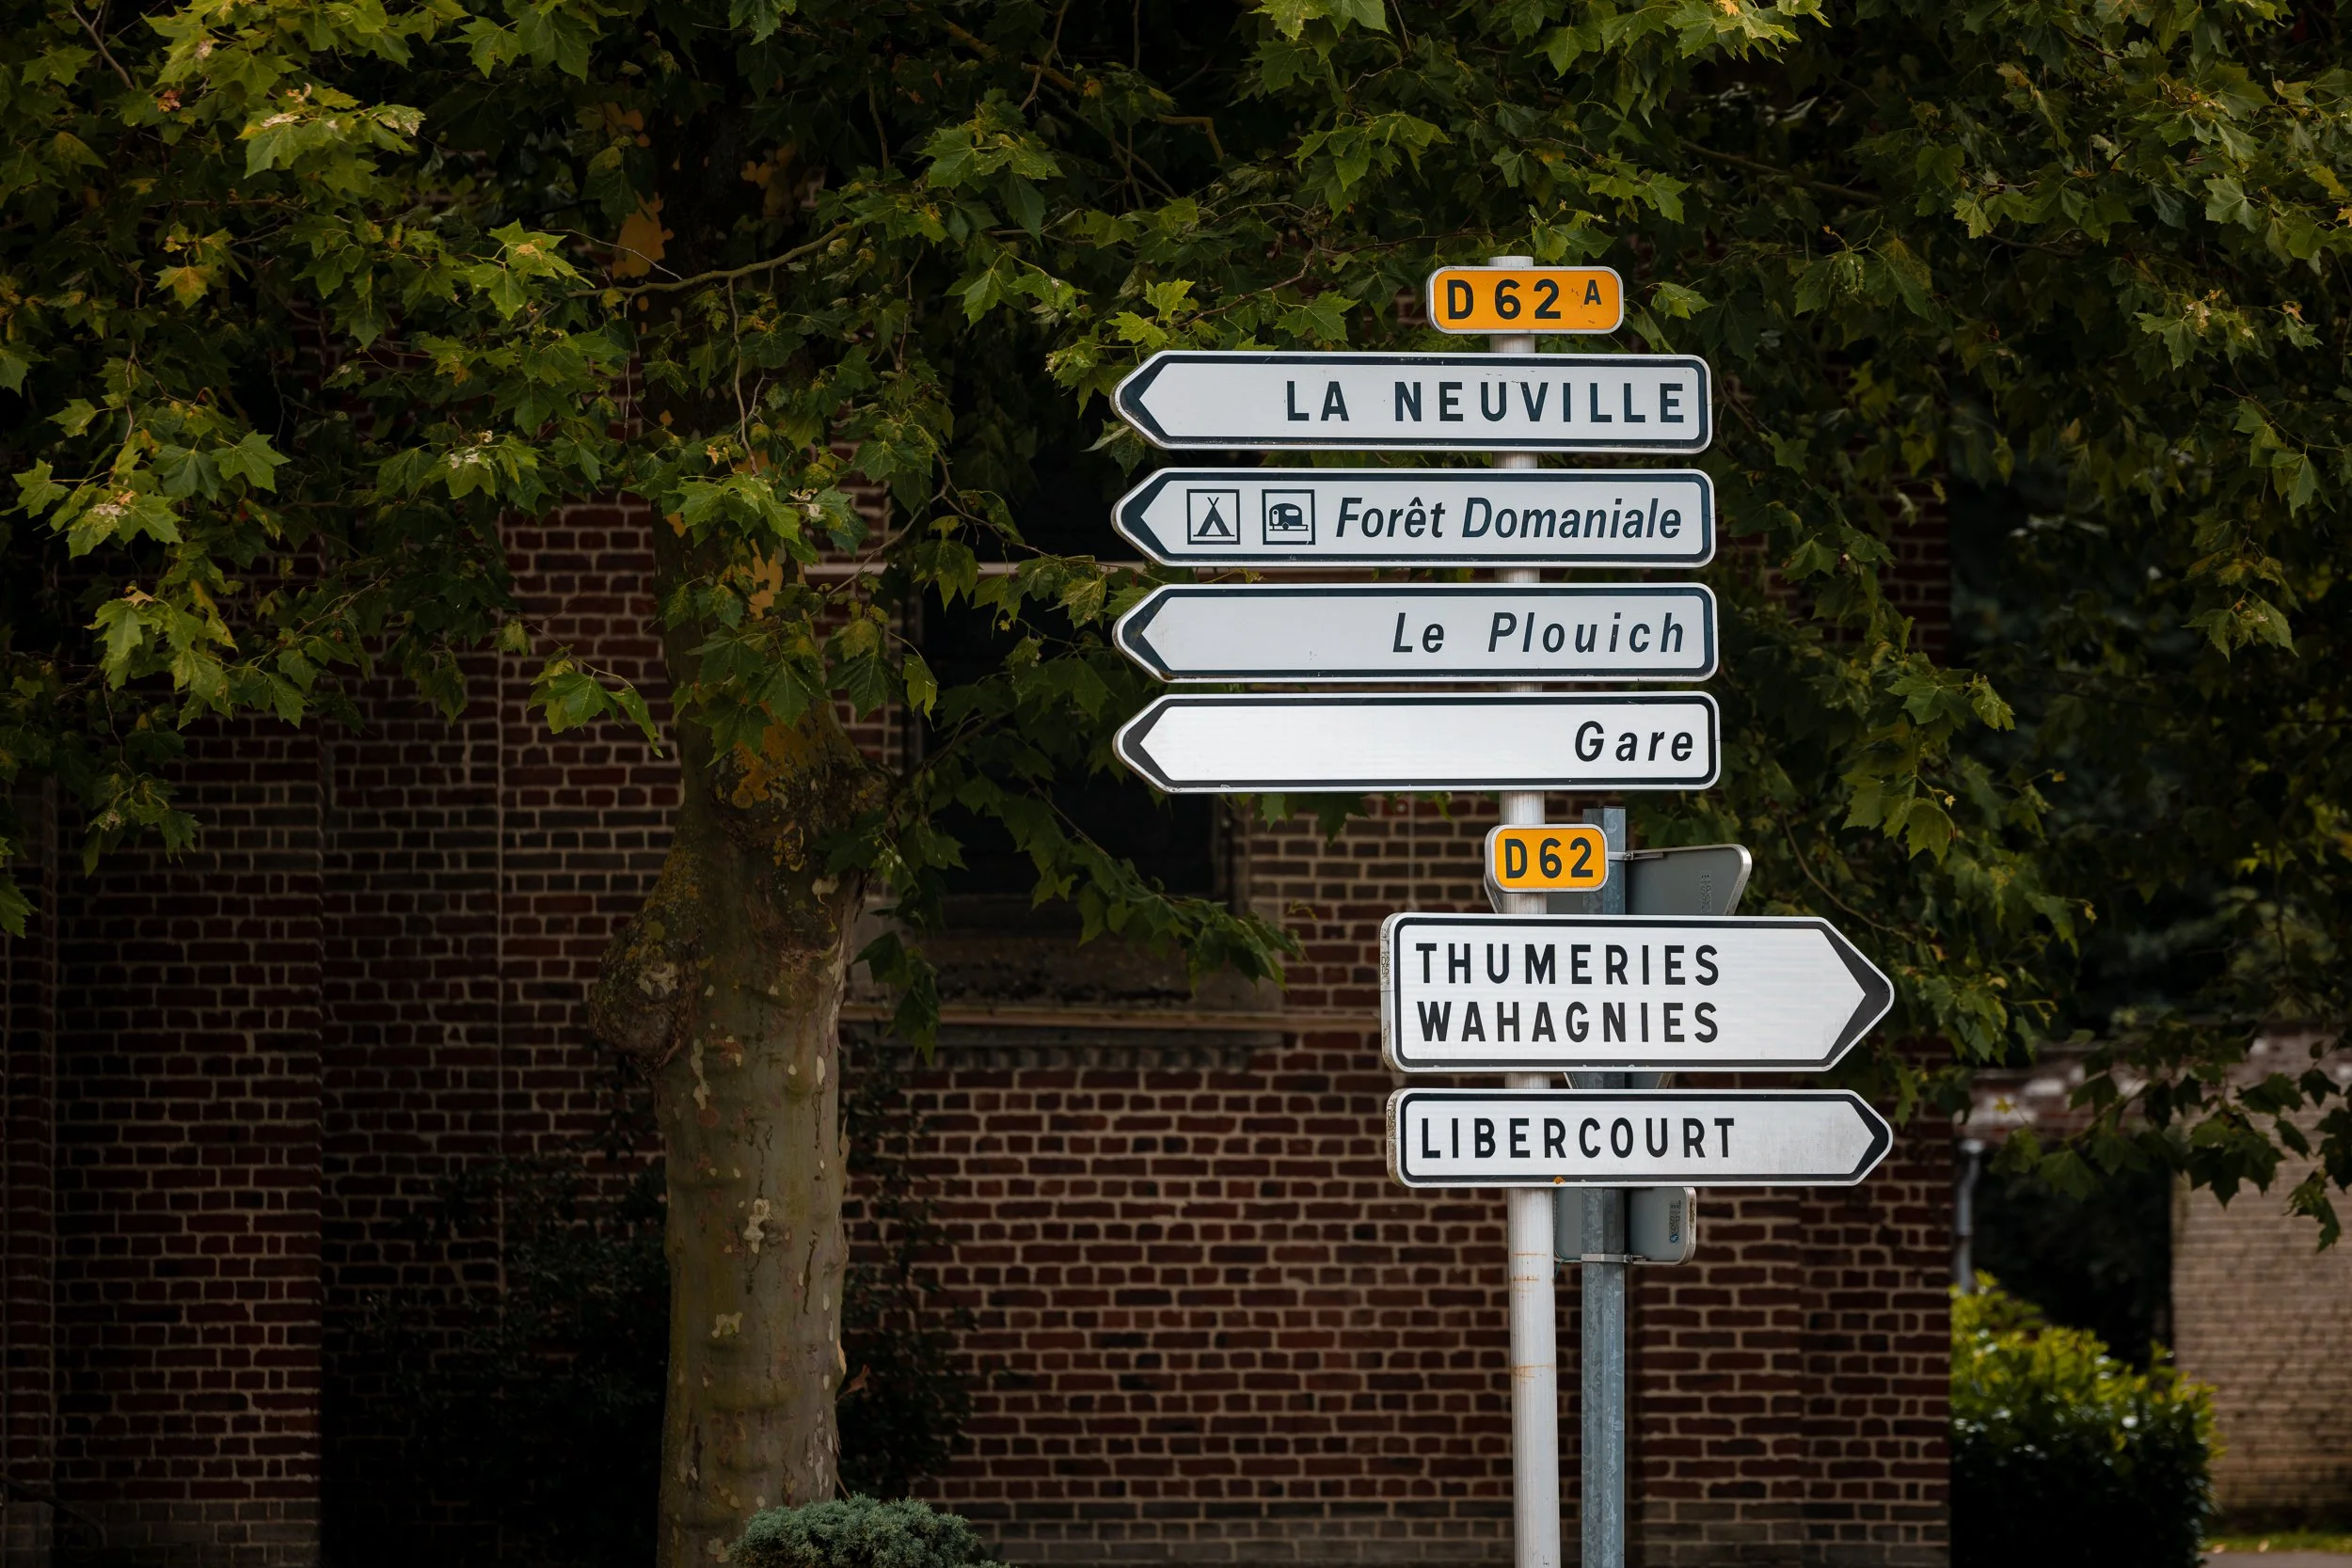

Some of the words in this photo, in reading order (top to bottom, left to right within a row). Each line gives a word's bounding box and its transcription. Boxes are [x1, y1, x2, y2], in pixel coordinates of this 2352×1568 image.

[1287, 381, 1349, 421] LA
[1395, 382, 1683, 422] NEUVILLE
[1336, 497, 1445, 538] Forêt
[1462, 498, 1680, 538] Domaniale
[1393, 612, 1444, 653] Le
[1488, 612, 1683, 653] Plouich
[1575, 721, 1692, 762] Gare
[1416, 943, 1718, 986] THUMERIES
[1417, 1002, 1718, 1043] WAHAGNIES
[1422, 1117, 1734, 1158] LIBERCOURT
